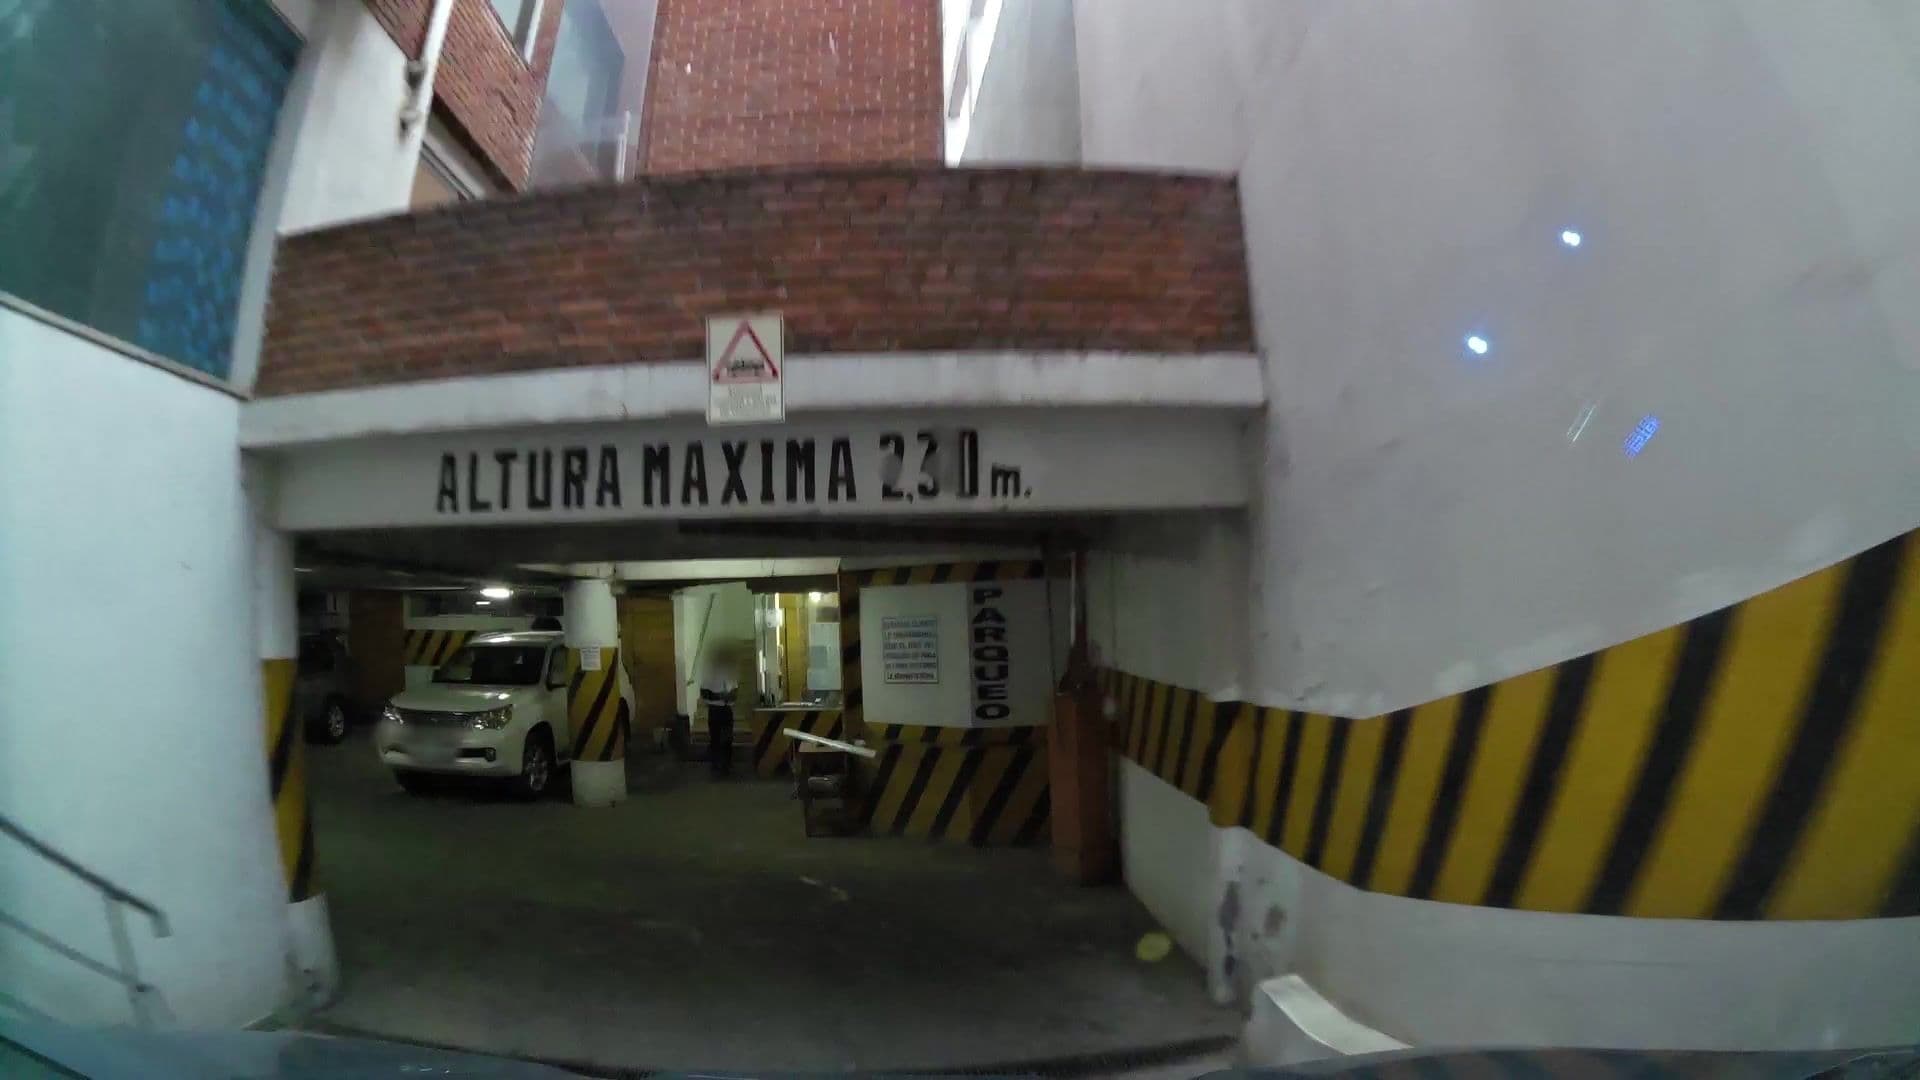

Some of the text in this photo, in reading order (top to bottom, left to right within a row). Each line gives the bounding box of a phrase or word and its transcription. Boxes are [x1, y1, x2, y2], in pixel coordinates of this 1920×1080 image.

[436, 444, 623, 513] ALTURA
[642, 434, 857, 507] MAXIMA
[991, 463, 1032, 499] m.
[972, 588, 1010, 720] PARQUEO
